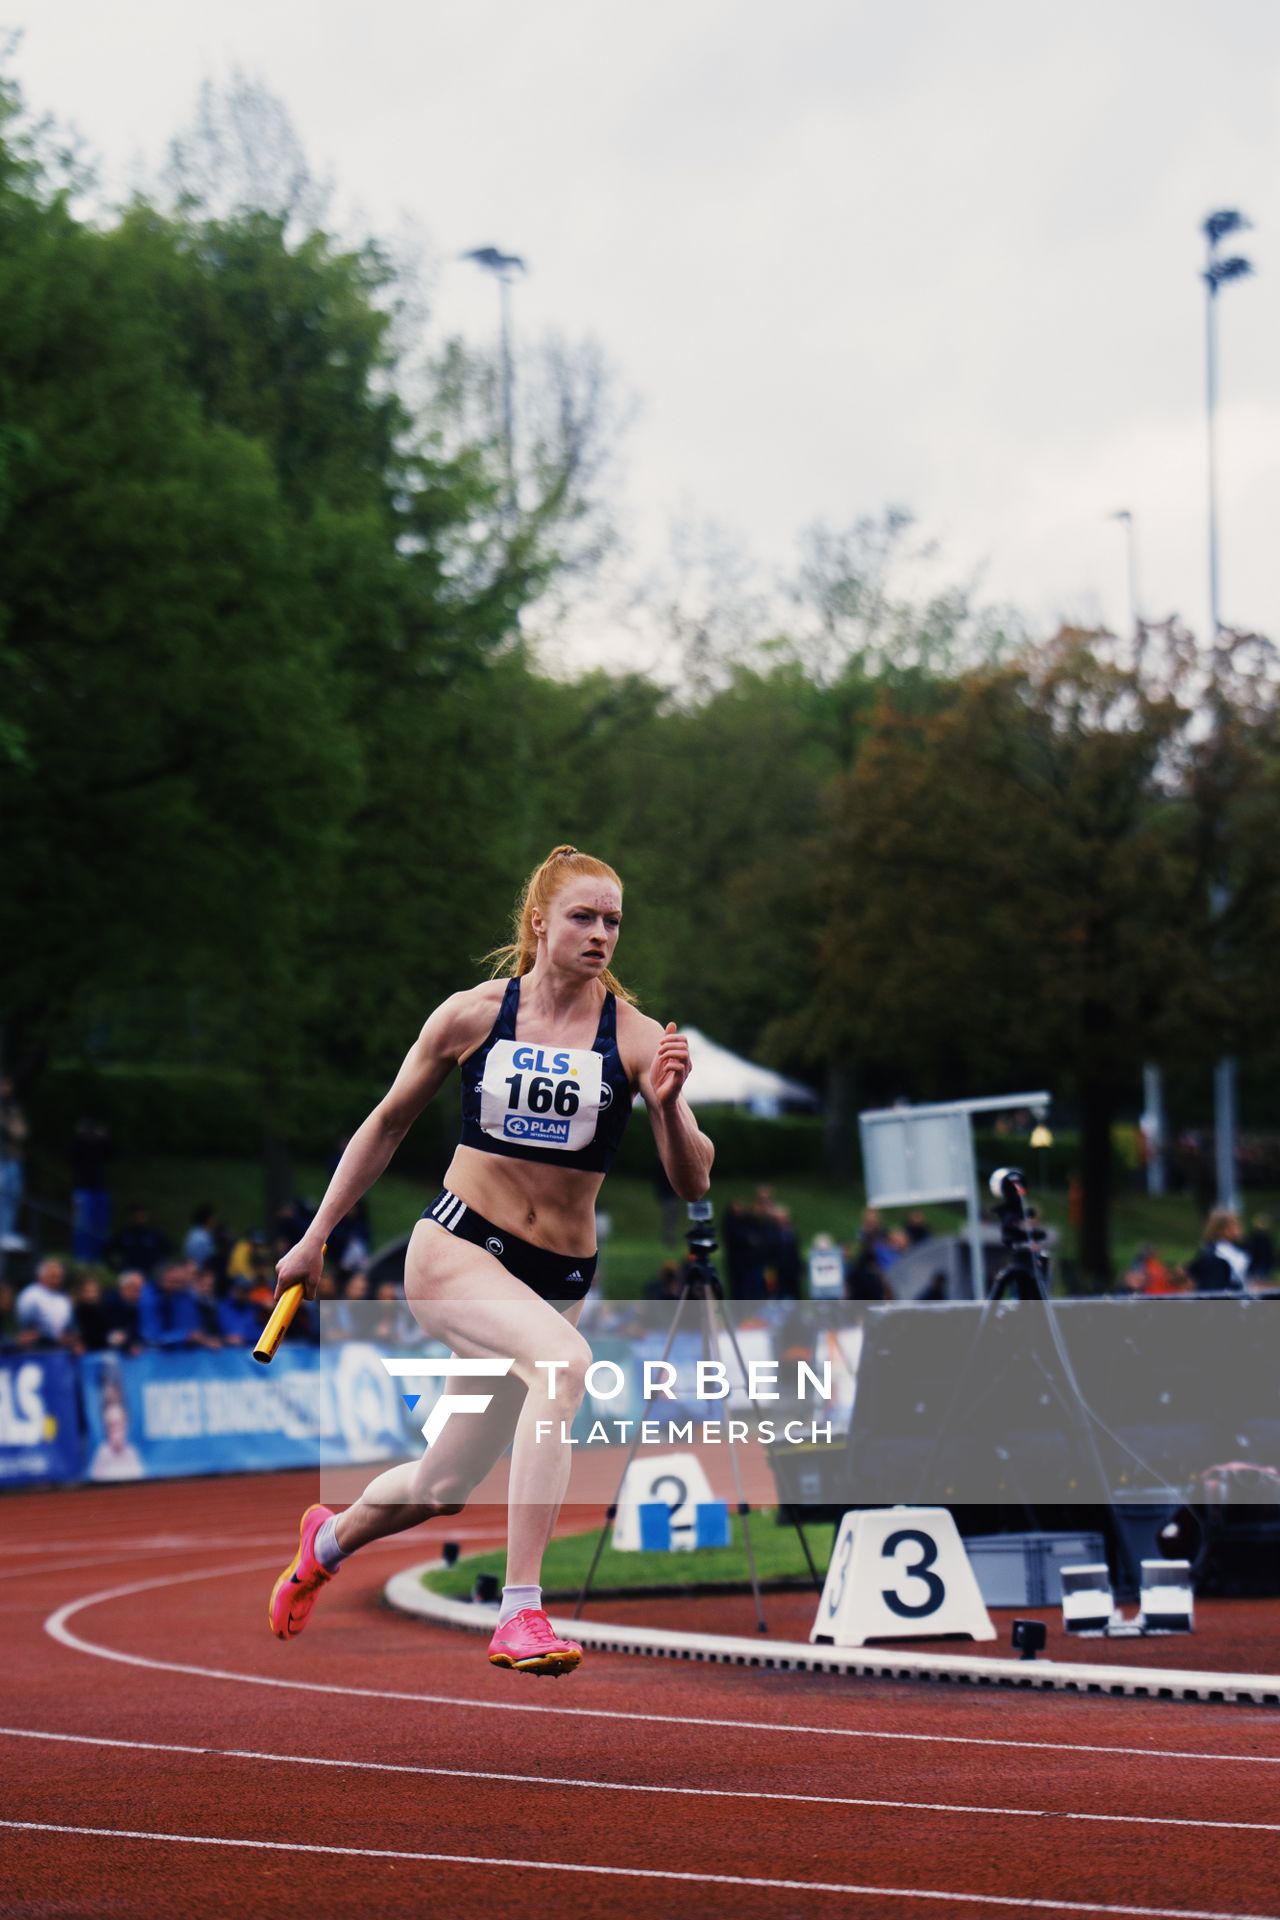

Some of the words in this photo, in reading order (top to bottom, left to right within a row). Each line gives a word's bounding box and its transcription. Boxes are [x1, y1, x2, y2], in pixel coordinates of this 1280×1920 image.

[505, 1073, 580, 1117] 166
[531, 1121, 567, 1135] PLAN
[650, 1475, 693, 1532] 2
[881, 1529, 946, 1618] 3
